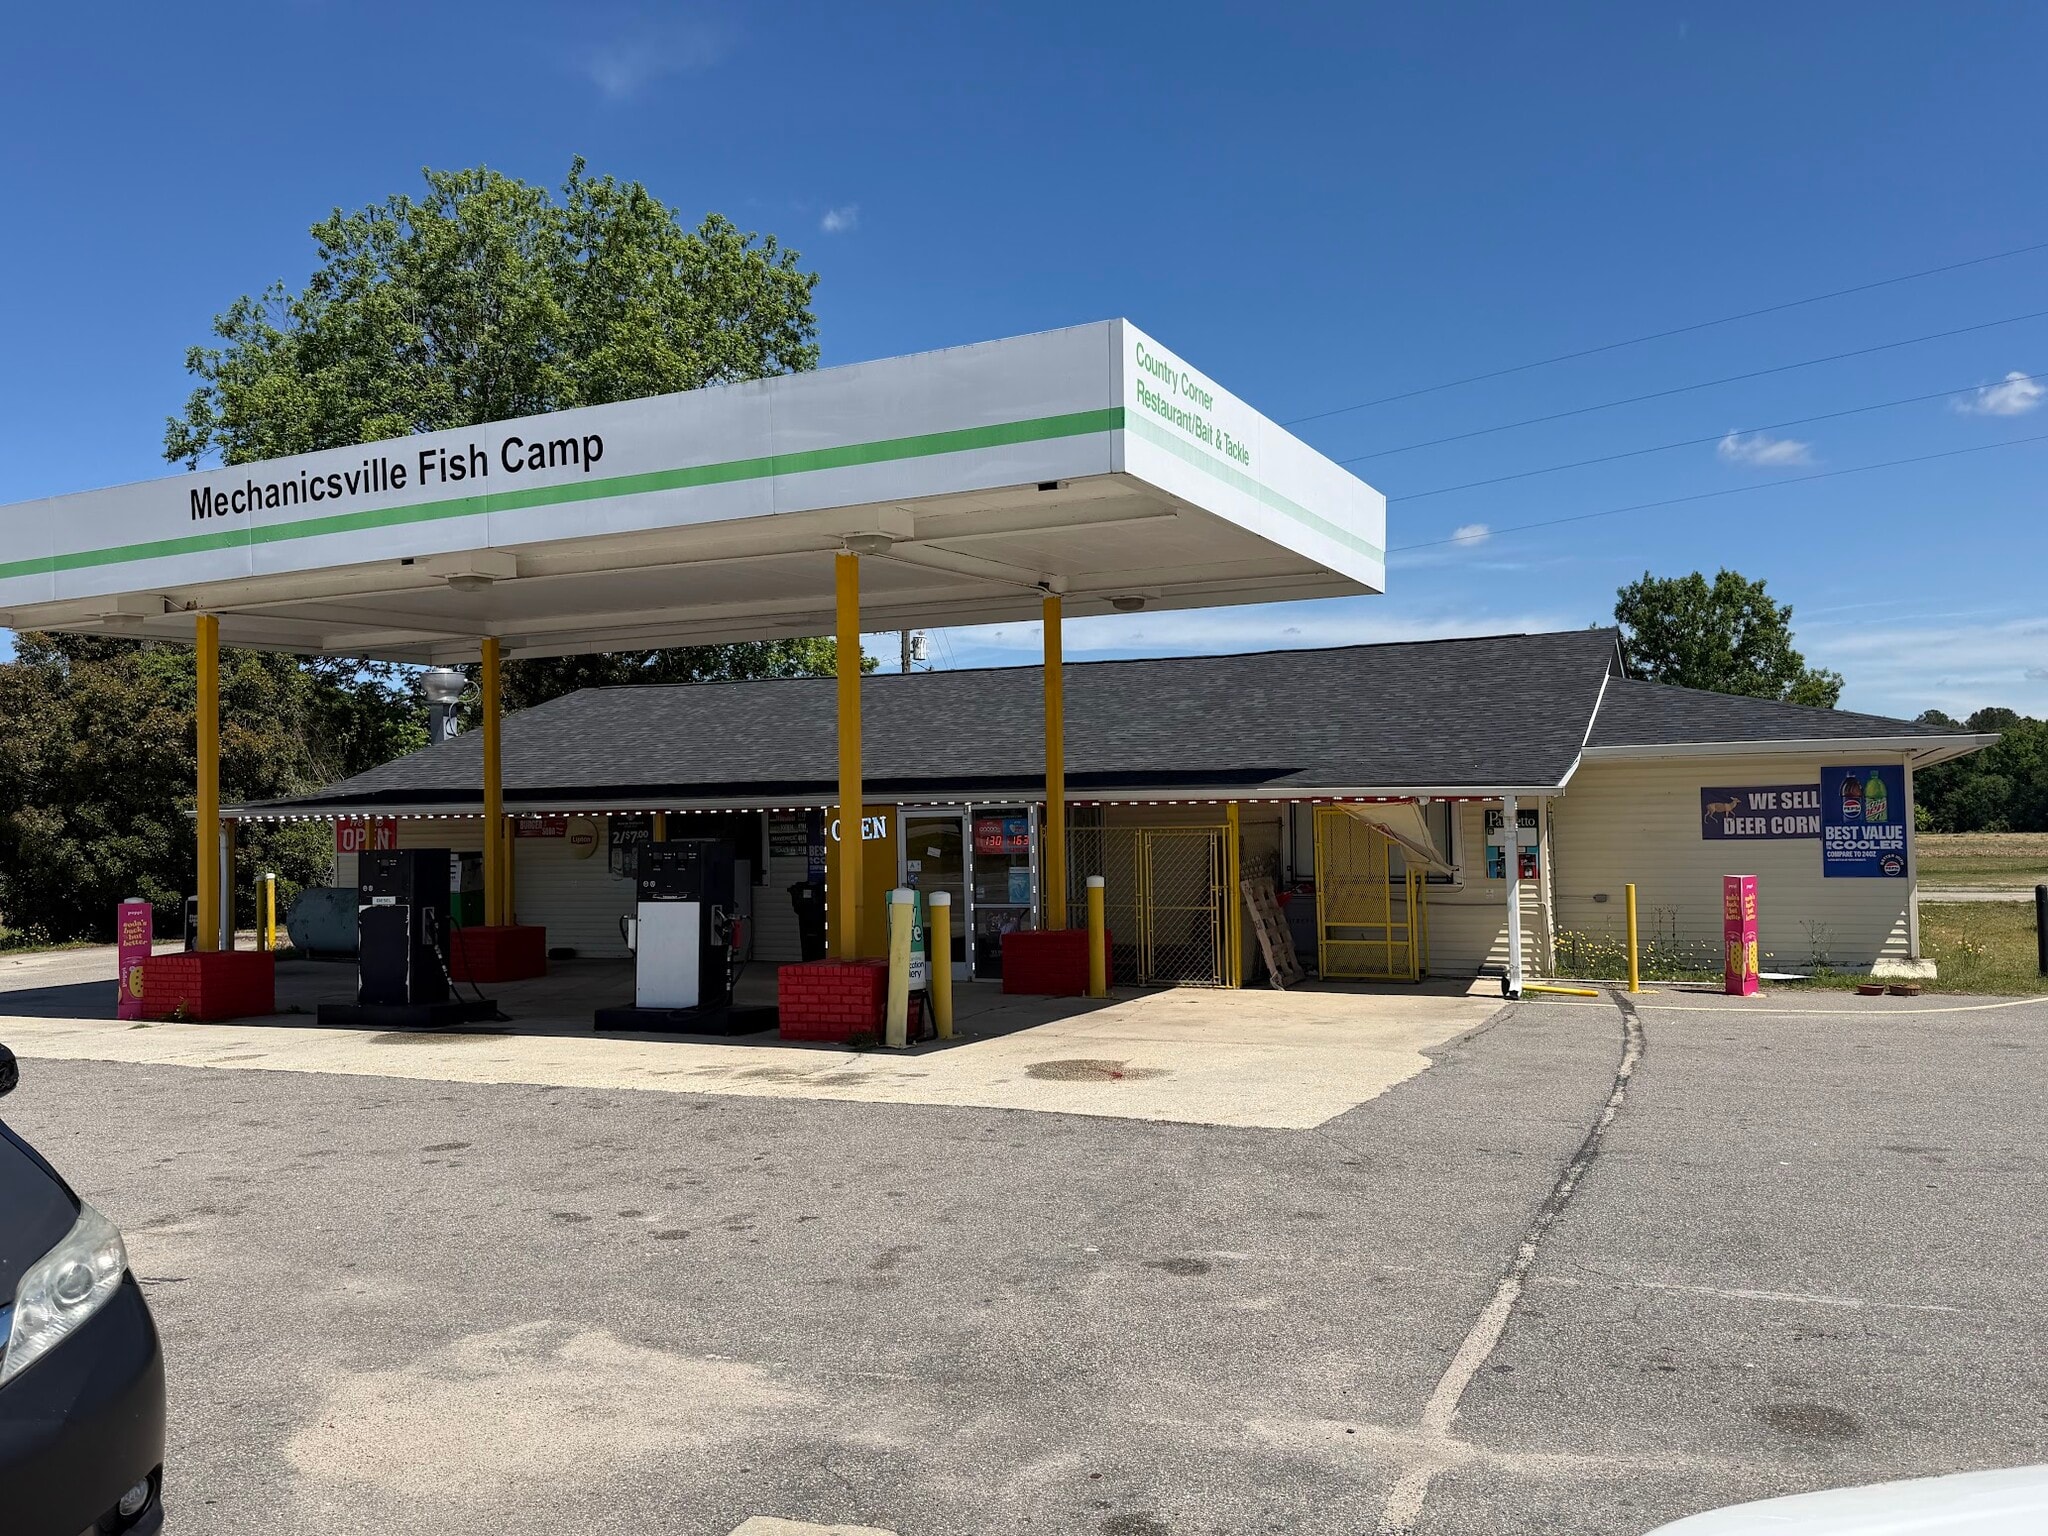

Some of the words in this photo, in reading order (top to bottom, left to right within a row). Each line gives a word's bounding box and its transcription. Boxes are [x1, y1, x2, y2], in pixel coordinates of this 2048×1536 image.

[1136, 342, 1178, 394] Country
[1181, 372, 1213, 412] Corner
[1137, 379, 1213, 446] Restaurant/Bait
[1216, 428, 1222, 451] &
[1224, 432, 1249, 466] Tackle
[190, 457, 407, 520] Mechanicsville
[419, 444, 488, 485] Fish
[501, 434, 604, 472] Camp
[1748, 793, 1778, 811] WE
[1781, 791, 1820, 810] SELL
[1488, 811, 1536, 827] Paetto
[1723, 817, 1767, 835] DEER
[1771, 815, 1820, 834] CORN
[831, 815, 887, 842] OEN
[1825, 826, 1859, 840] BEST
[1861, 825, 1903, 840] VALUE
[342, 828, 389, 851] OPN
[572, 836, 591, 844] Lipton
[1832, 840, 1904, 850] COOLER
[809, 845, 825, 857] BES
[123, 919, 148, 928] soda's
[122, 939, 148, 947] better
